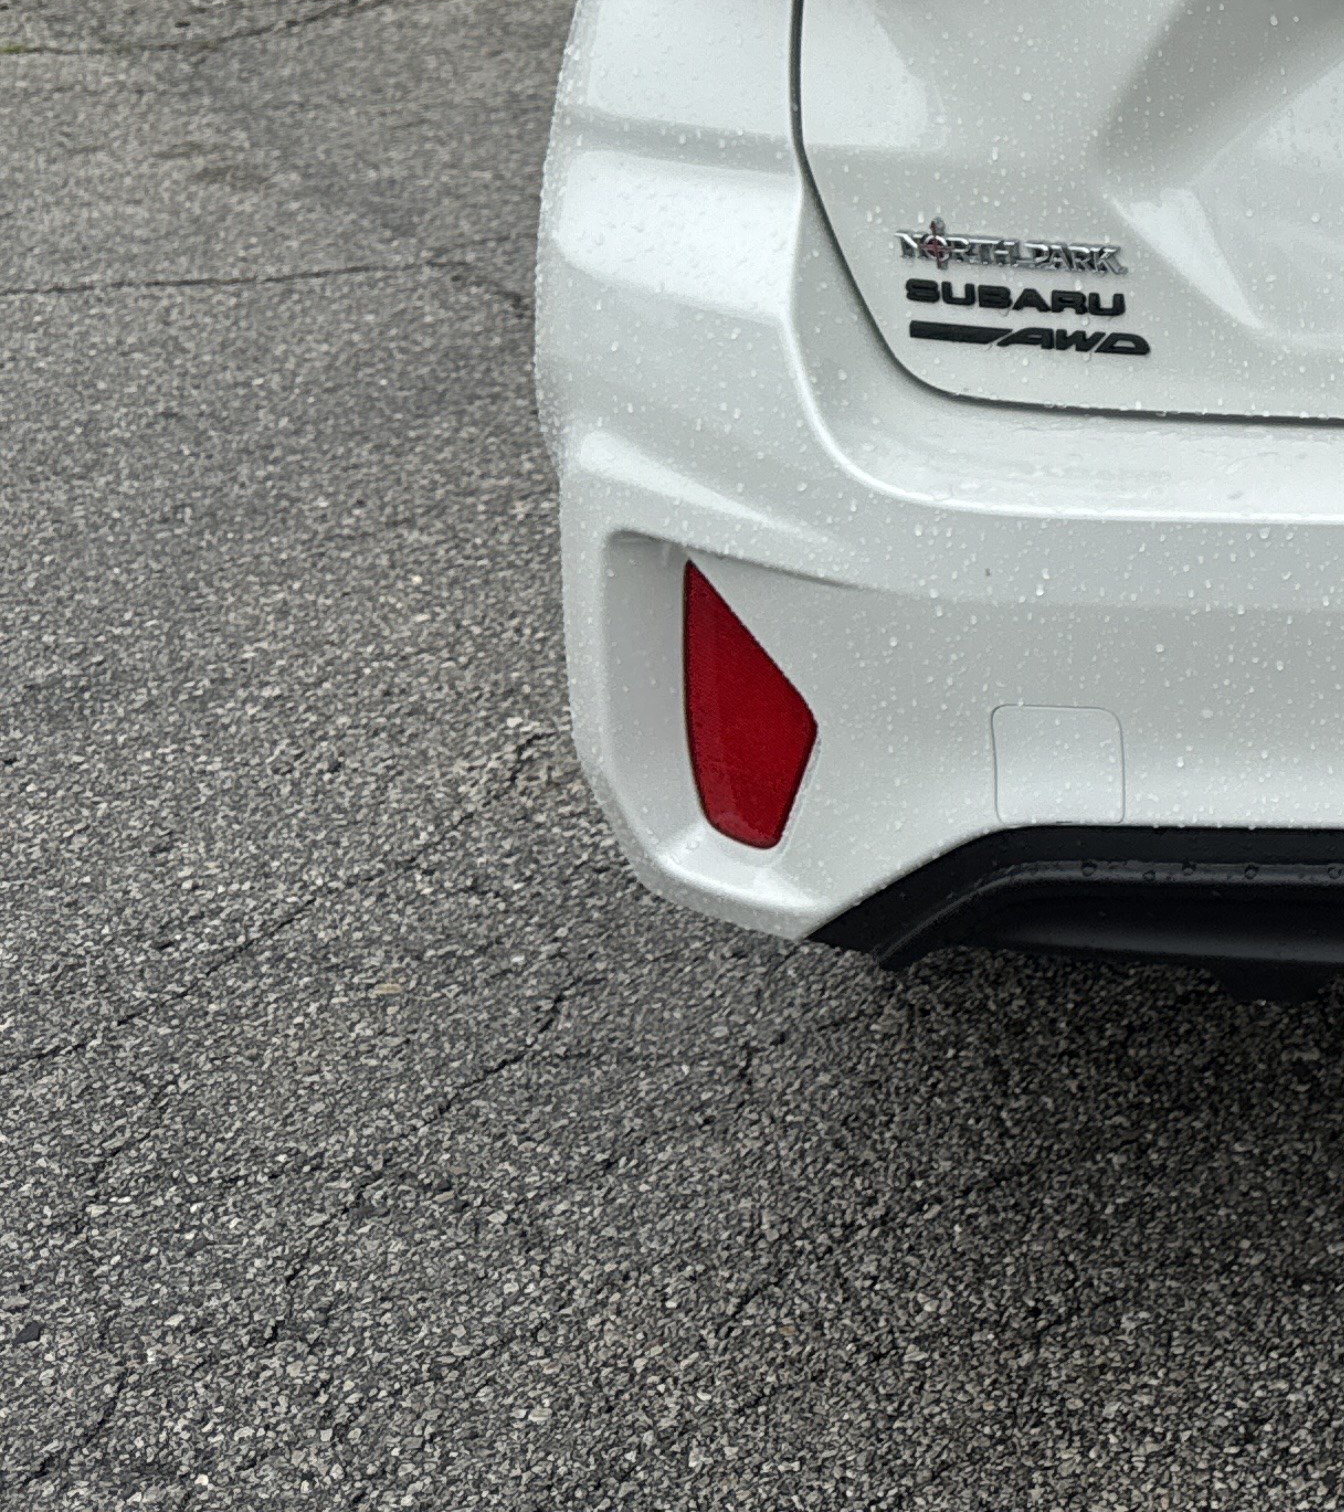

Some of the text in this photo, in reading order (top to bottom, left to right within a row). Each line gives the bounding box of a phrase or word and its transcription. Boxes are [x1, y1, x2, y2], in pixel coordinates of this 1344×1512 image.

[894, 230, 1128, 275] NORTH PARK
[905, 278, 1126, 317] SUBARU
[996, 325, 1151, 355] AWD
